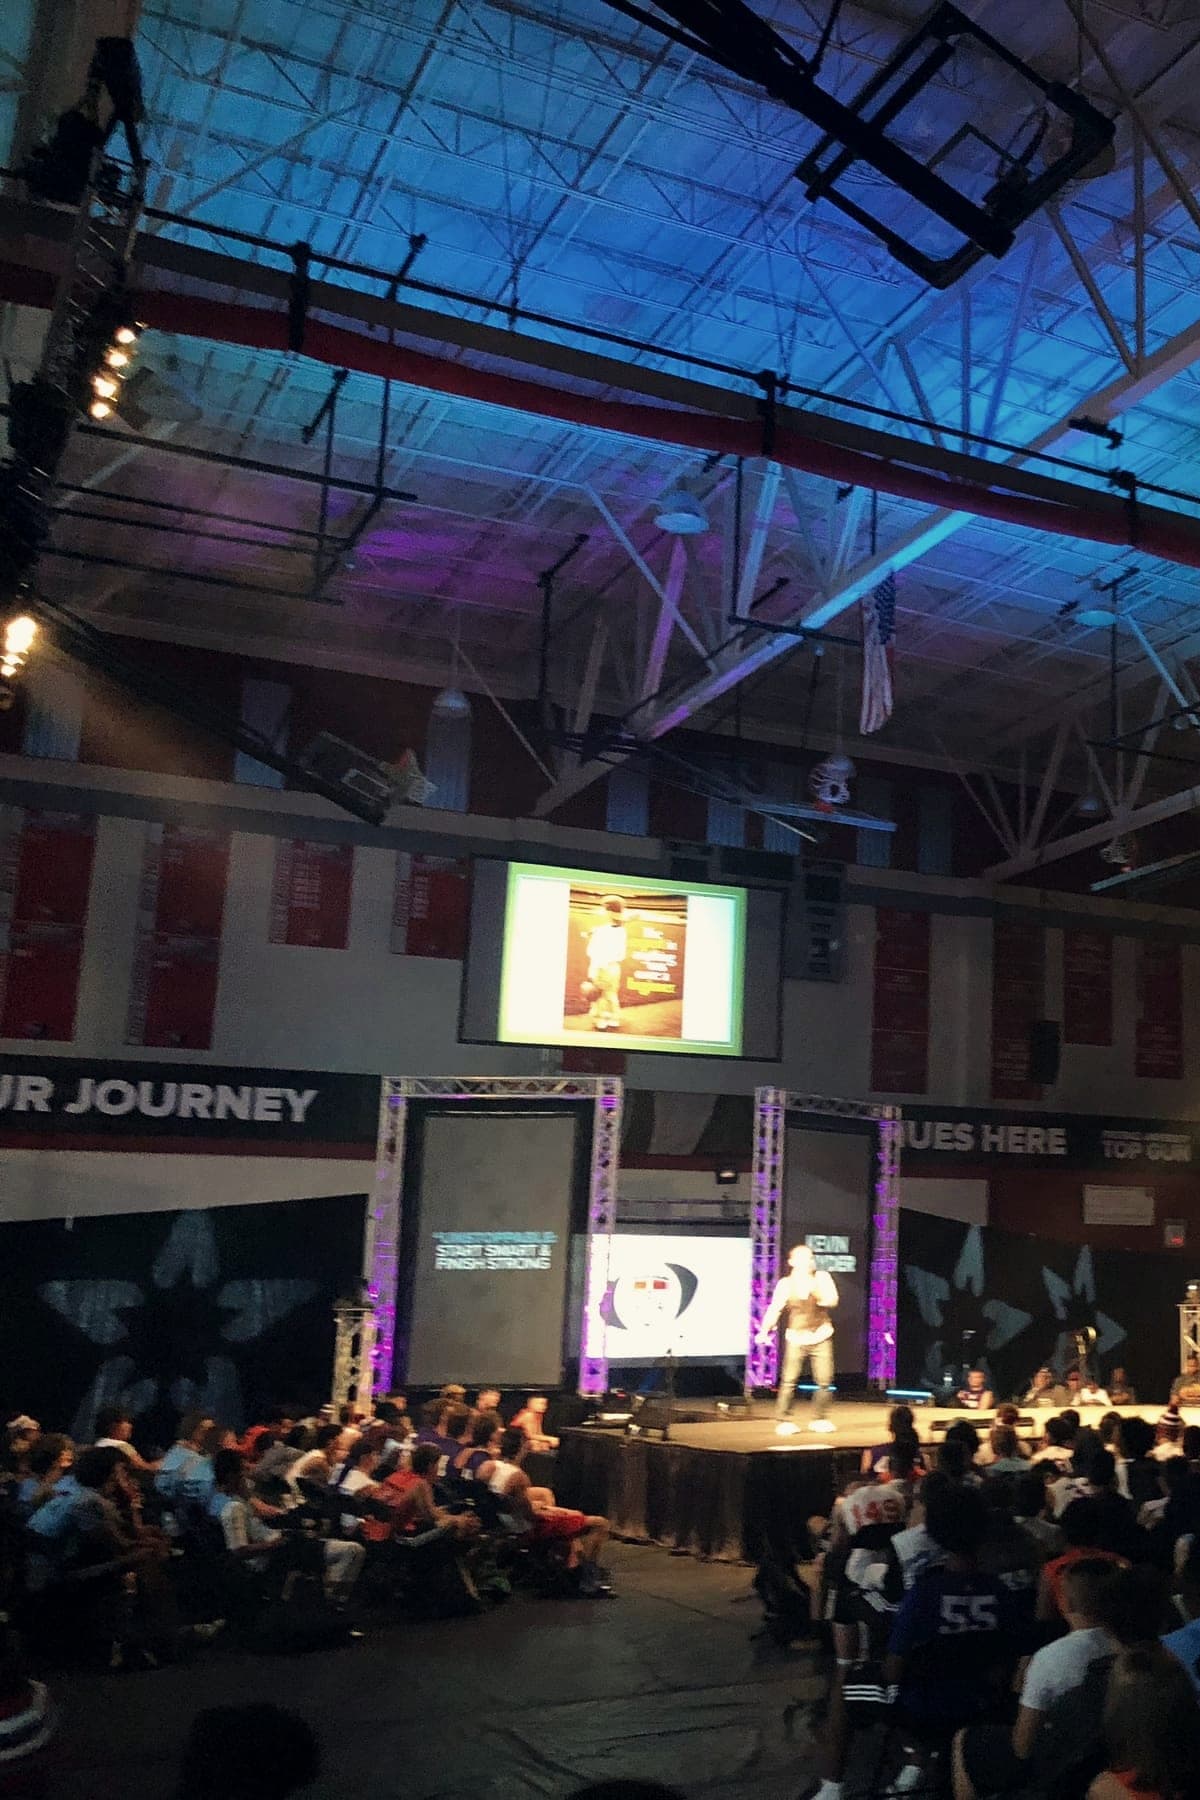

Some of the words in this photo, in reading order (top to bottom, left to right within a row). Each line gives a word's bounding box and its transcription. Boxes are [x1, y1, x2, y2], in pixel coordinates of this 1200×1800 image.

[65, 1077, 320, 1124] JOURNEY
[981, 1125, 1069, 1155] HERE
[436, 1244, 482, 1256] START
[487, 1257, 551, 1269] STRONG
[937, 1594, 999, 1635] 55
